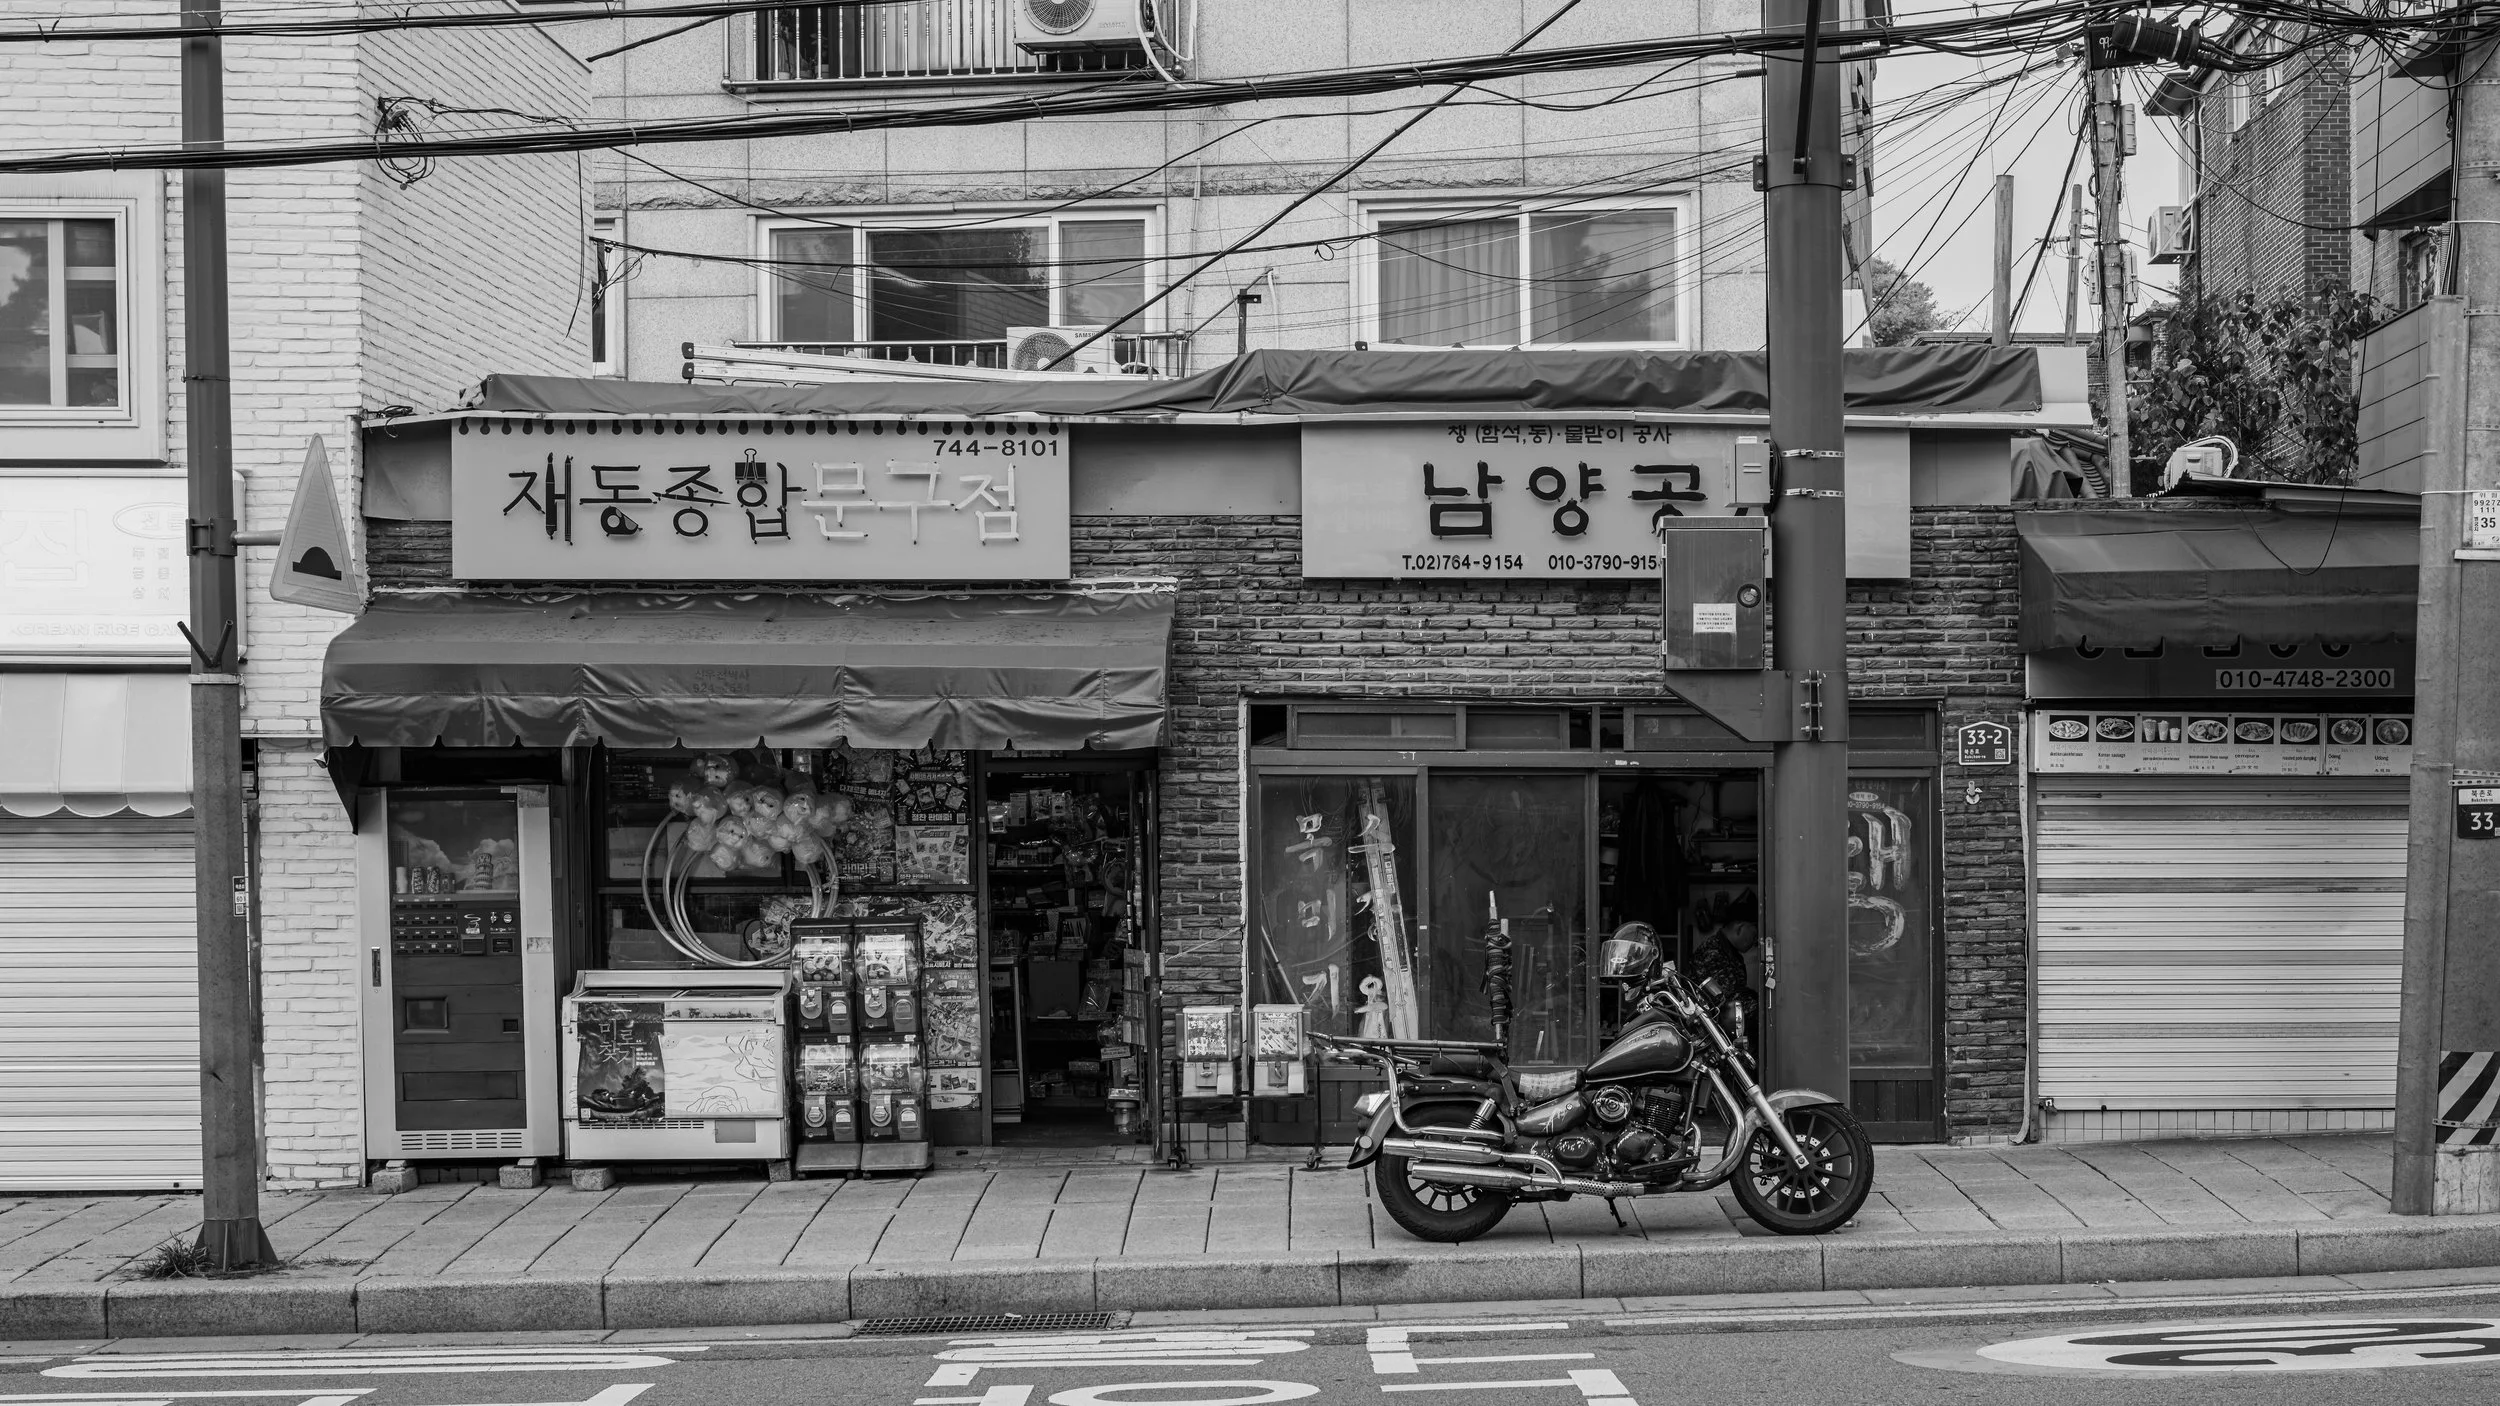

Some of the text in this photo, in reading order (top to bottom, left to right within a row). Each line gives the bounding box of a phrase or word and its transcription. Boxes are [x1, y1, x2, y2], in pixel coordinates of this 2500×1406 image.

[1448, 424, 1467, 444] 챙
[1633, 424, 1672, 445] 공사
[932, 439, 1060, 457] 744-8101
[503, 448, 1021, 546] 재동종합문구점
[1422, 460, 1712, 539] 남양공
[2480, 517, 2496, 529] 35
[1402, 554, 1661, 572] T.02)764-9154 010-3790-915
[94, 623, 140, 638] RICE
[2219, 669, 2392, 689] 010-4748-2300
[1966, 729, 2003, 745] 33-2
[2471, 789, 2493, 798] 북촌로
[2470, 812, 2494, 831] 33
[598, 1018, 647, 1046] 미로
